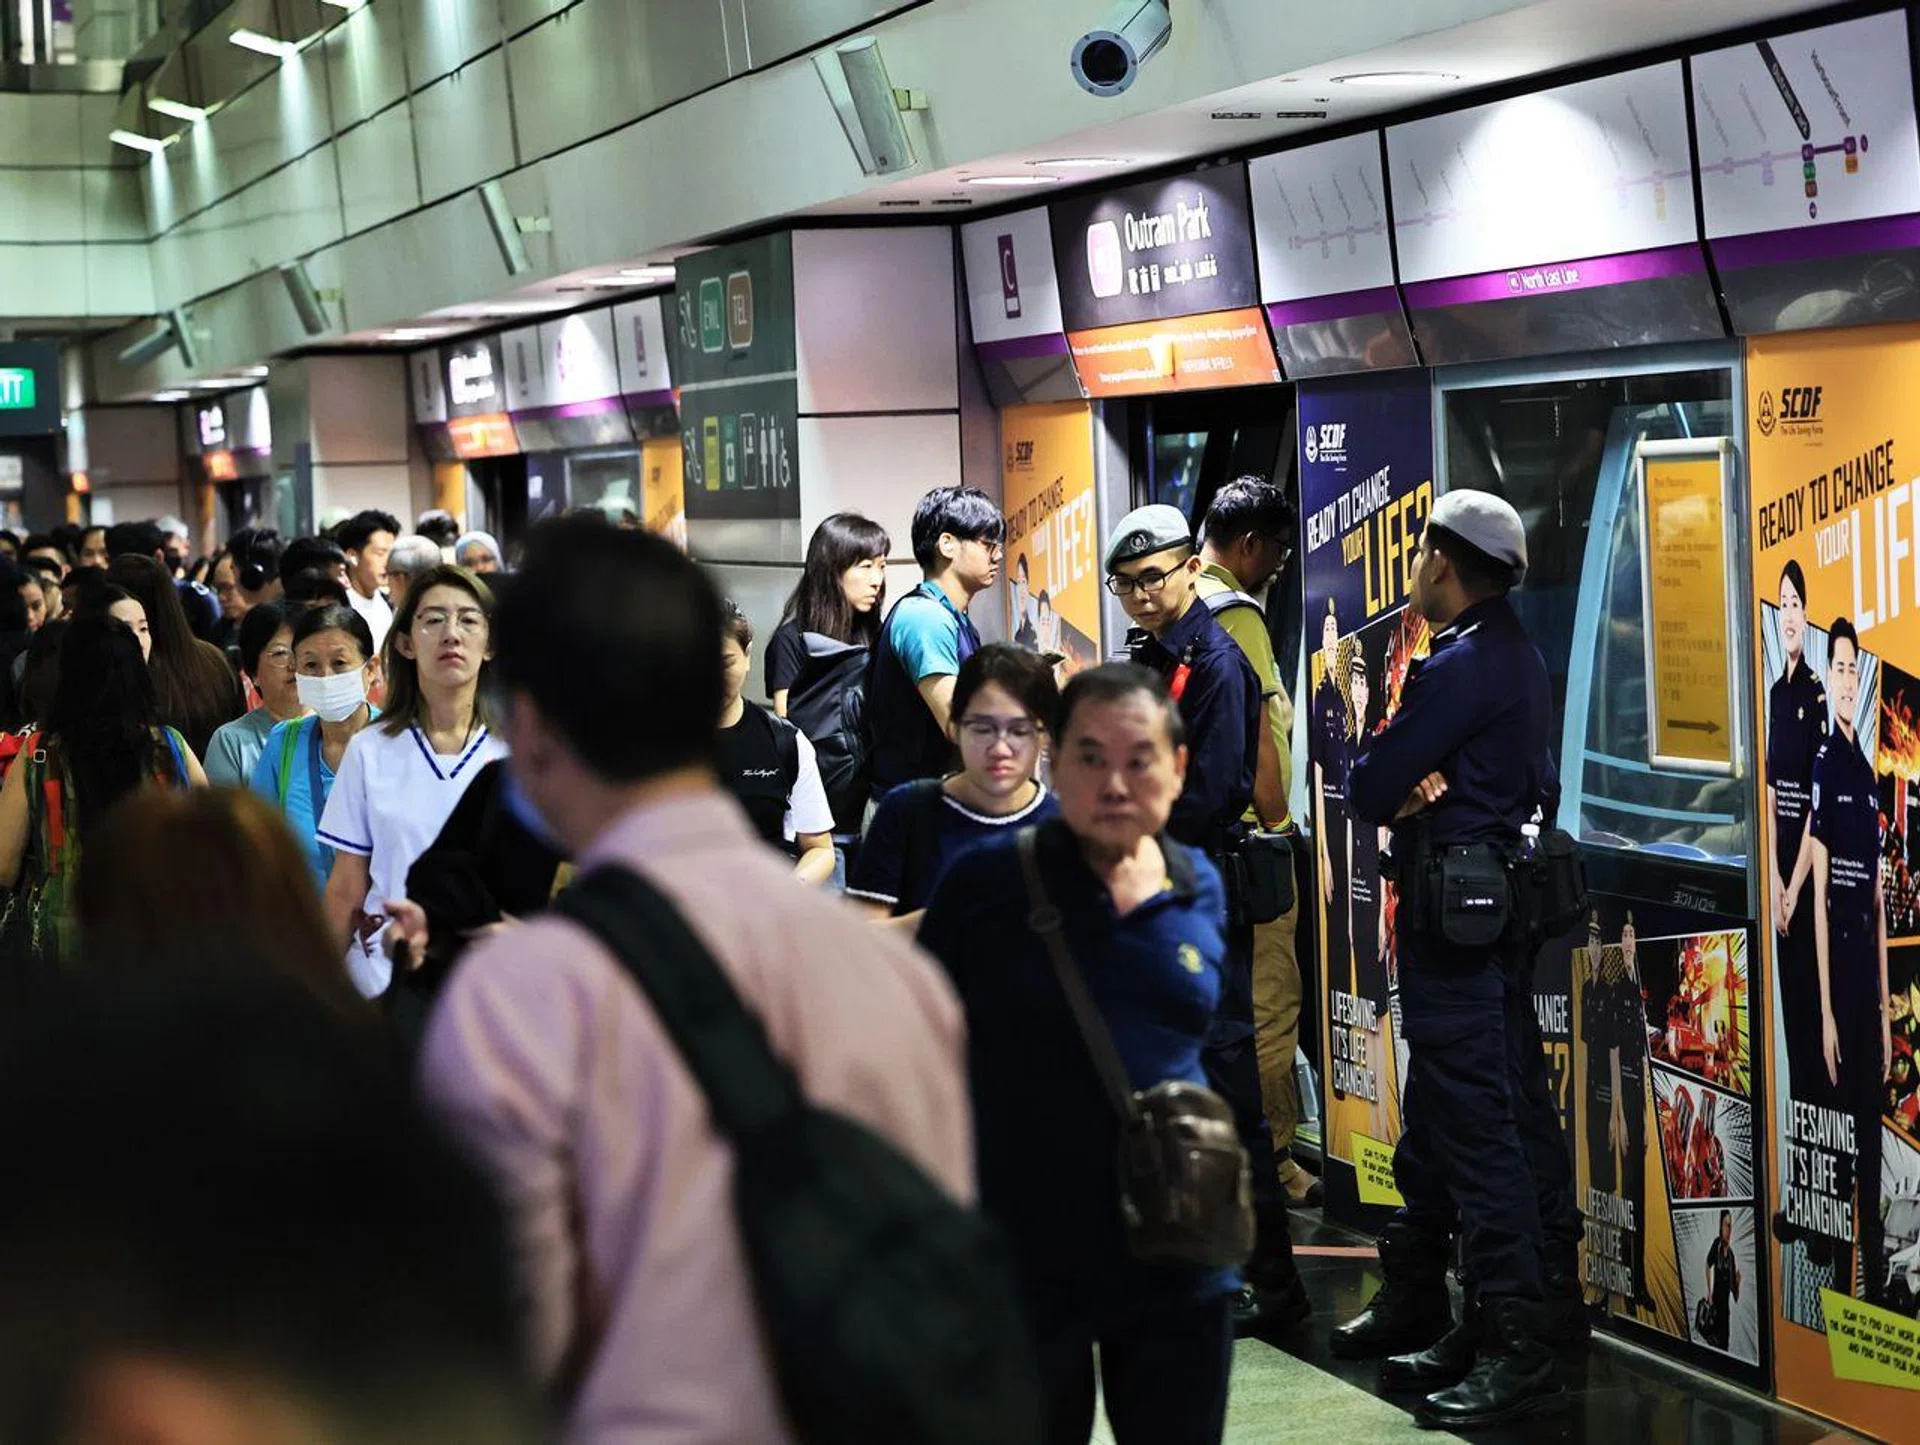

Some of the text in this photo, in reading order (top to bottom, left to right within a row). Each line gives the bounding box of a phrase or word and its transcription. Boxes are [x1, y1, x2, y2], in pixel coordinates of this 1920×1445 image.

[1124, 192, 1211, 252] Outram Park
[1003, 249, 1015, 290] C
[1520, 269, 1545, 290] North
[1544, 269, 1562, 286] East
[1561, 264, 1581, 285] Line
[732, 294, 748, 326] TEL
[1780, 386, 1823, 419] SCDF
[1319, 423, 1346, 449] SCDF
[1028, 497, 1038, 531] TO
[1038, 475, 1064, 523] CHANGE
[1307, 465, 1391, 553] READY TO CHANGE
[1759, 439, 1895, 551] READY TO CHANGE
[1048, 487, 1093, 600] LIFE?
[1341, 526, 1365, 567] YOUR
[1815, 517, 1849, 568] YOUR
[1331, 990, 1379, 1032] LIFESAVING.
[1332, 1026, 1367, 1067] IT'S LIFE
[1334, 1059, 1379, 1103] CHANGING.
[1784, 1099, 1859, 1156] LIFESAVING.
[1786, 1143, 1838, 1196] IT'S LIFE
[1583, 1185, 1637, 1232] LIFESAVING.
[1786, 1186, 1856, 1243] CHANGING.
[1584, 1220, 1622, 1261] IT'S LIFE
[1585, 1253, 1635, 1298] CHANGING.
